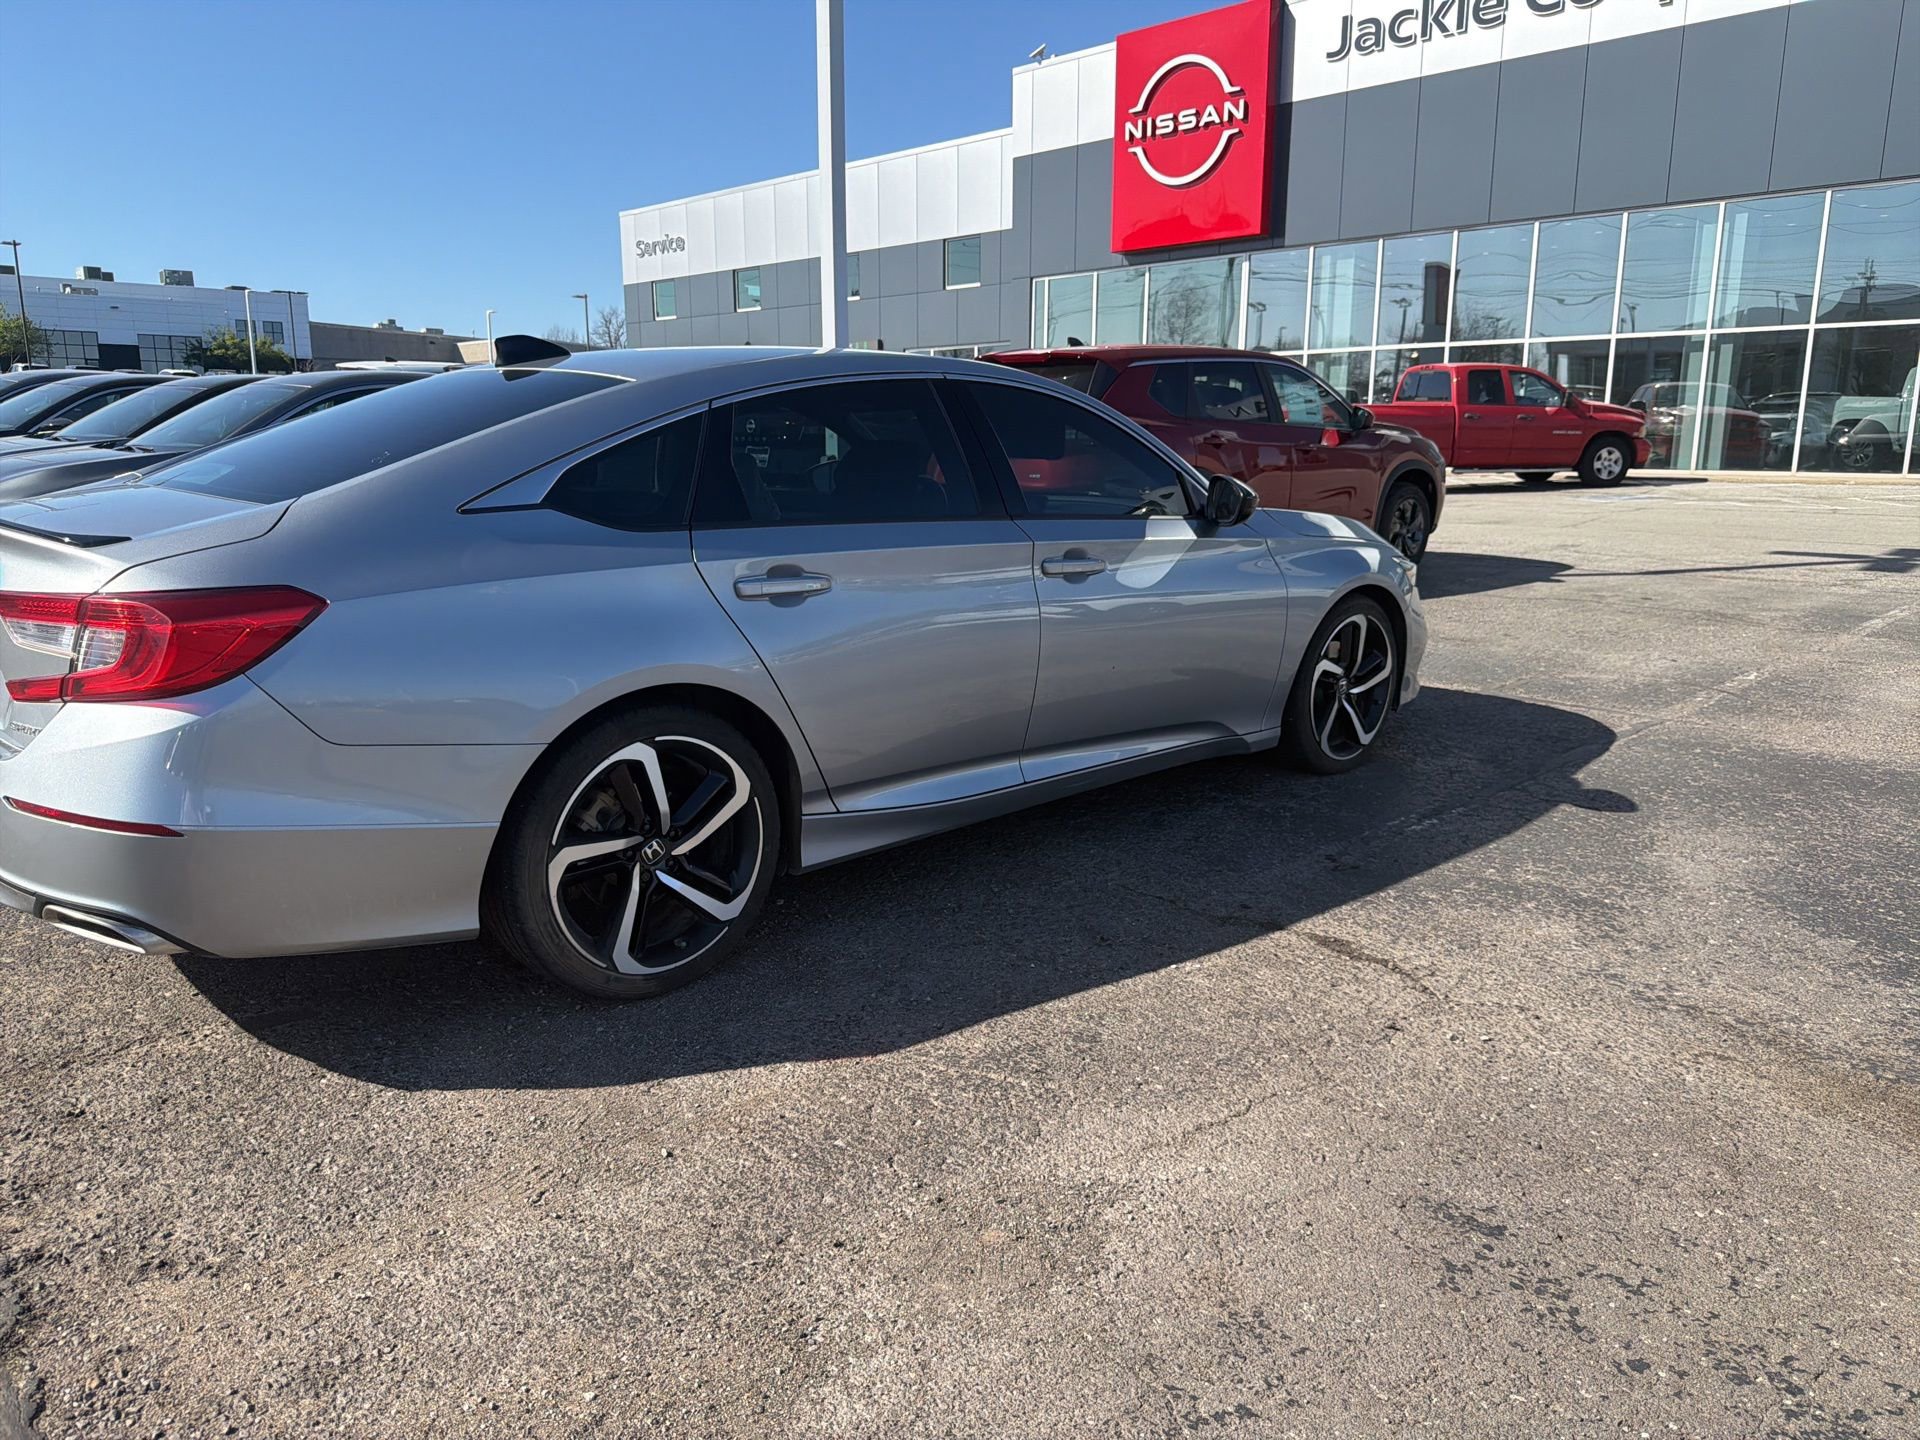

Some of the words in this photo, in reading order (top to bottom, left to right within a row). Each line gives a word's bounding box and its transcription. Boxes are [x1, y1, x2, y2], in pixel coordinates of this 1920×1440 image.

[1326, 0, 1508, 62] Jackie
[1124, 98, 1248, 143] NISSAN
[636, 234, 686, 258] Service
